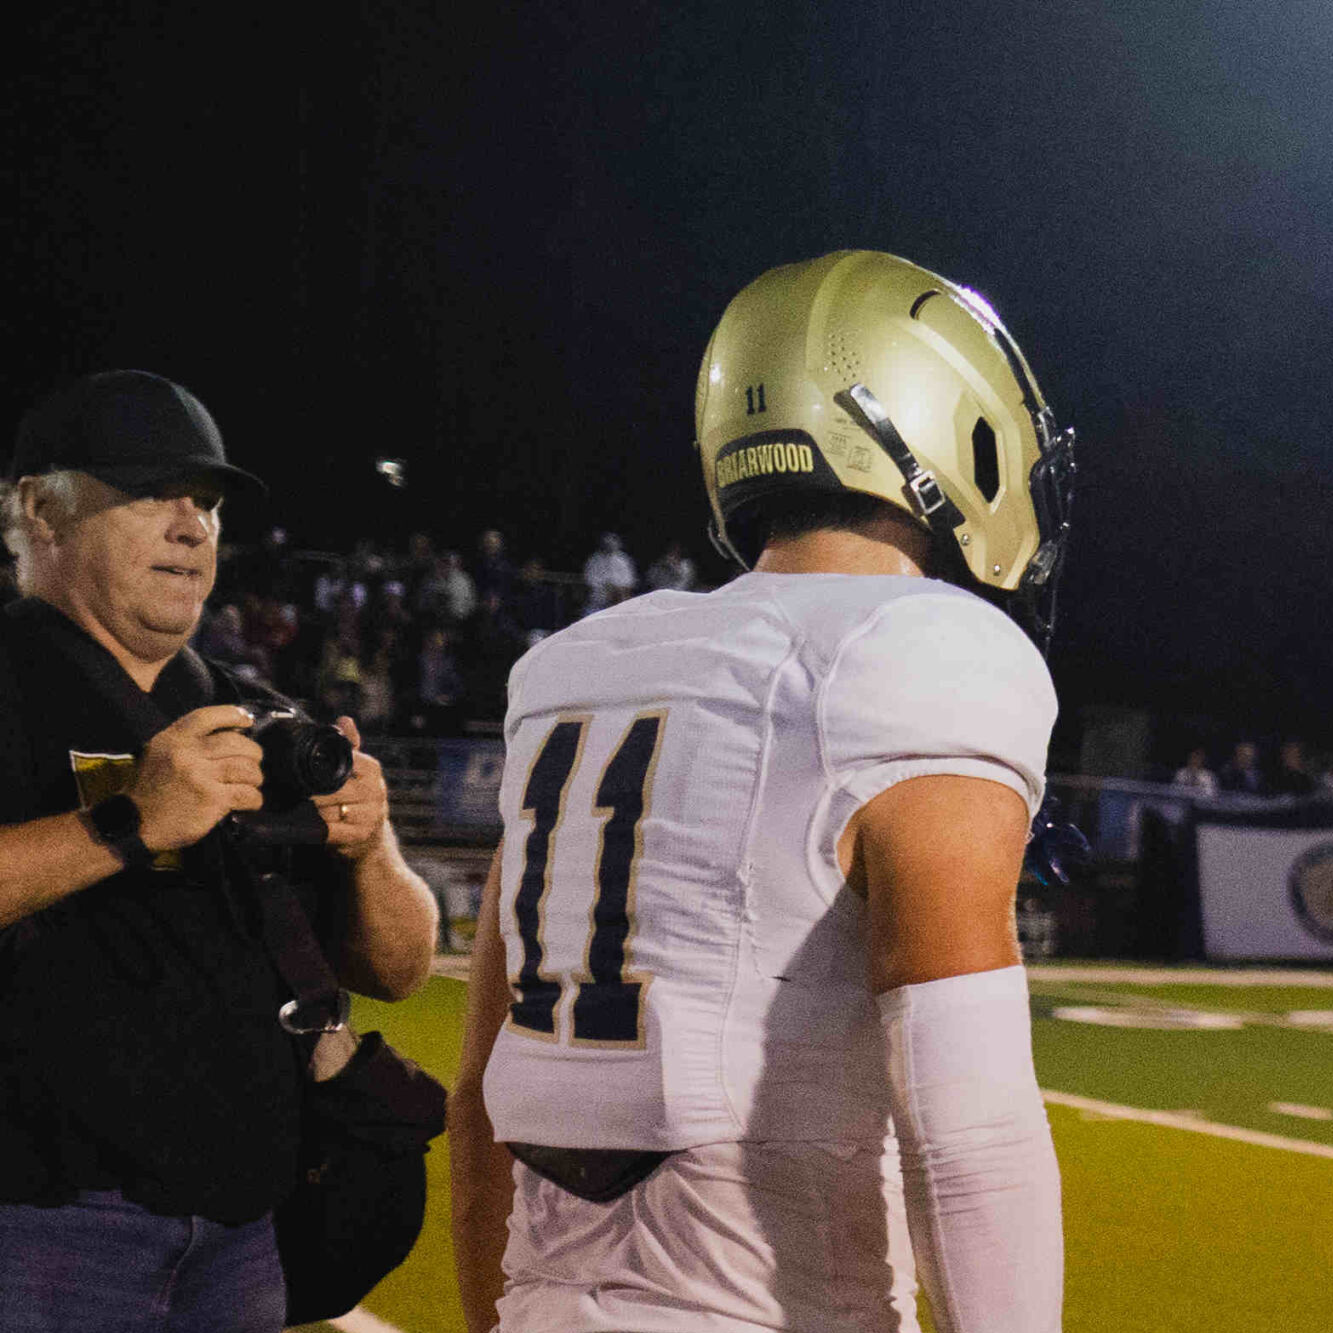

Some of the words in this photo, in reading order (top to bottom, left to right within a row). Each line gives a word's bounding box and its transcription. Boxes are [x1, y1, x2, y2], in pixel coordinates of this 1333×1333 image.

[745, 383, 767, 415] 11
[717, 443, 814, 489] BRIARWOOD
[508, 709, 669, 1050] 11
